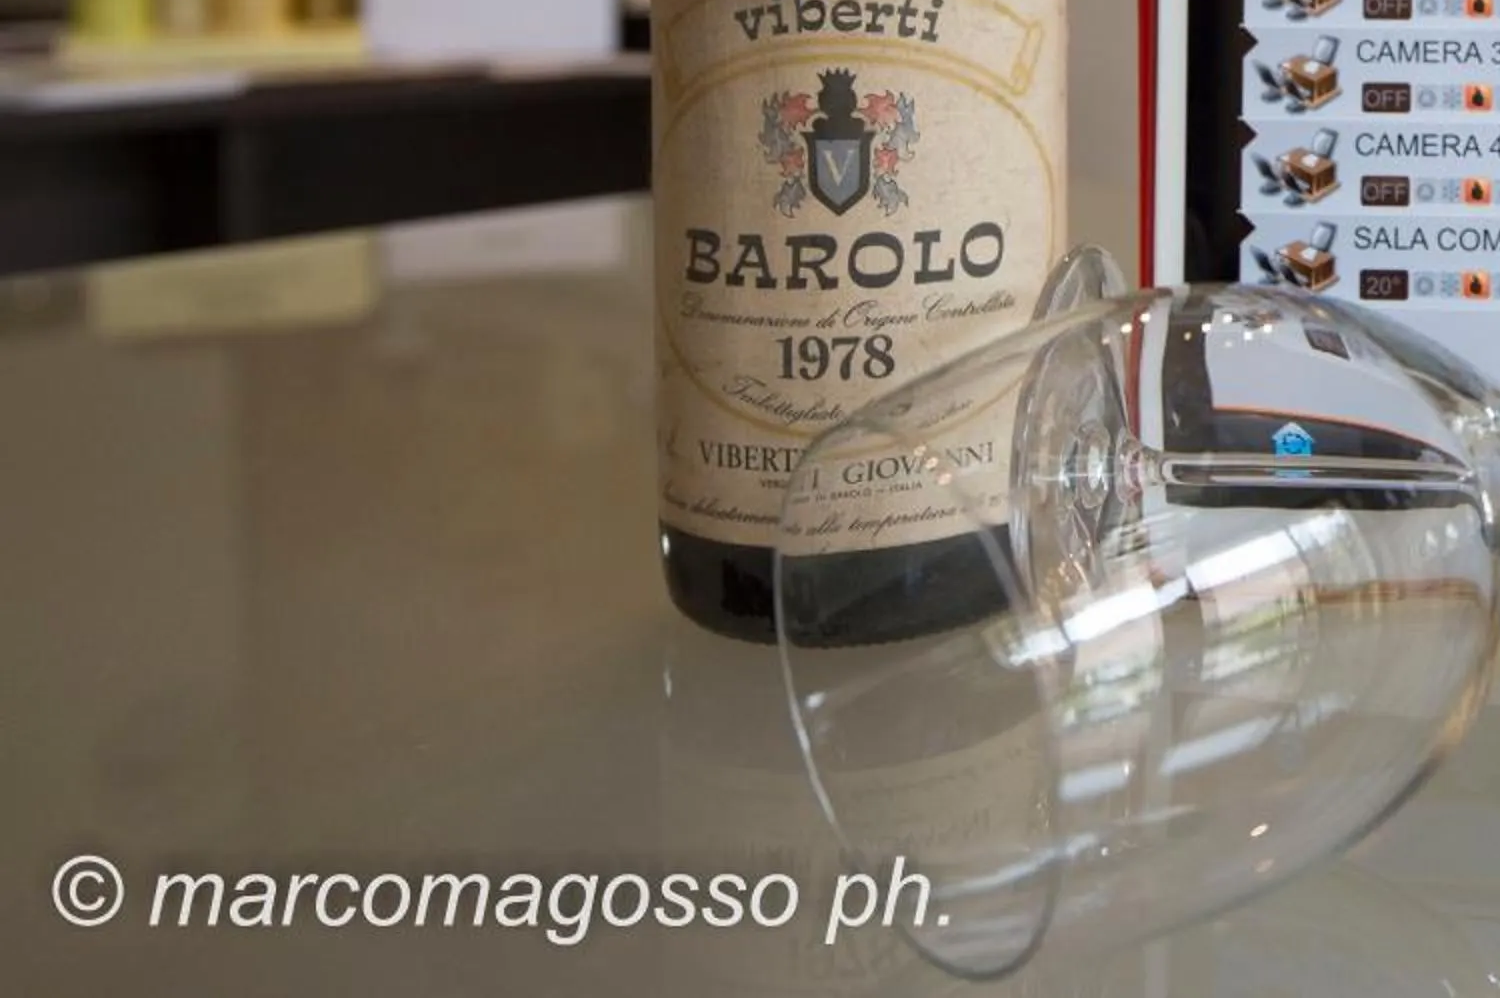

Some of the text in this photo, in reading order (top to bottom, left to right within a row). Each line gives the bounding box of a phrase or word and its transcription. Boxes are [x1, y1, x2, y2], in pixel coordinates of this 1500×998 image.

[1356, 40, 1482, 64] CAMERA
[1363, 89, 1409, 109] OFF
[1355, 133, 1481, 158] CAMERA
[819, 149, 855, 188] V
[1362, 182, 1408, 202] OFF
[1353, 227, 1429, 251] SALA
[685, 221, 1005, 291] BAROLO
[815, 307, 842, 330] di
[843, 299, 919, 332] Origine
[922, 290, 1016, 322] Controllata
[775, 333, 896, 381] 1978
